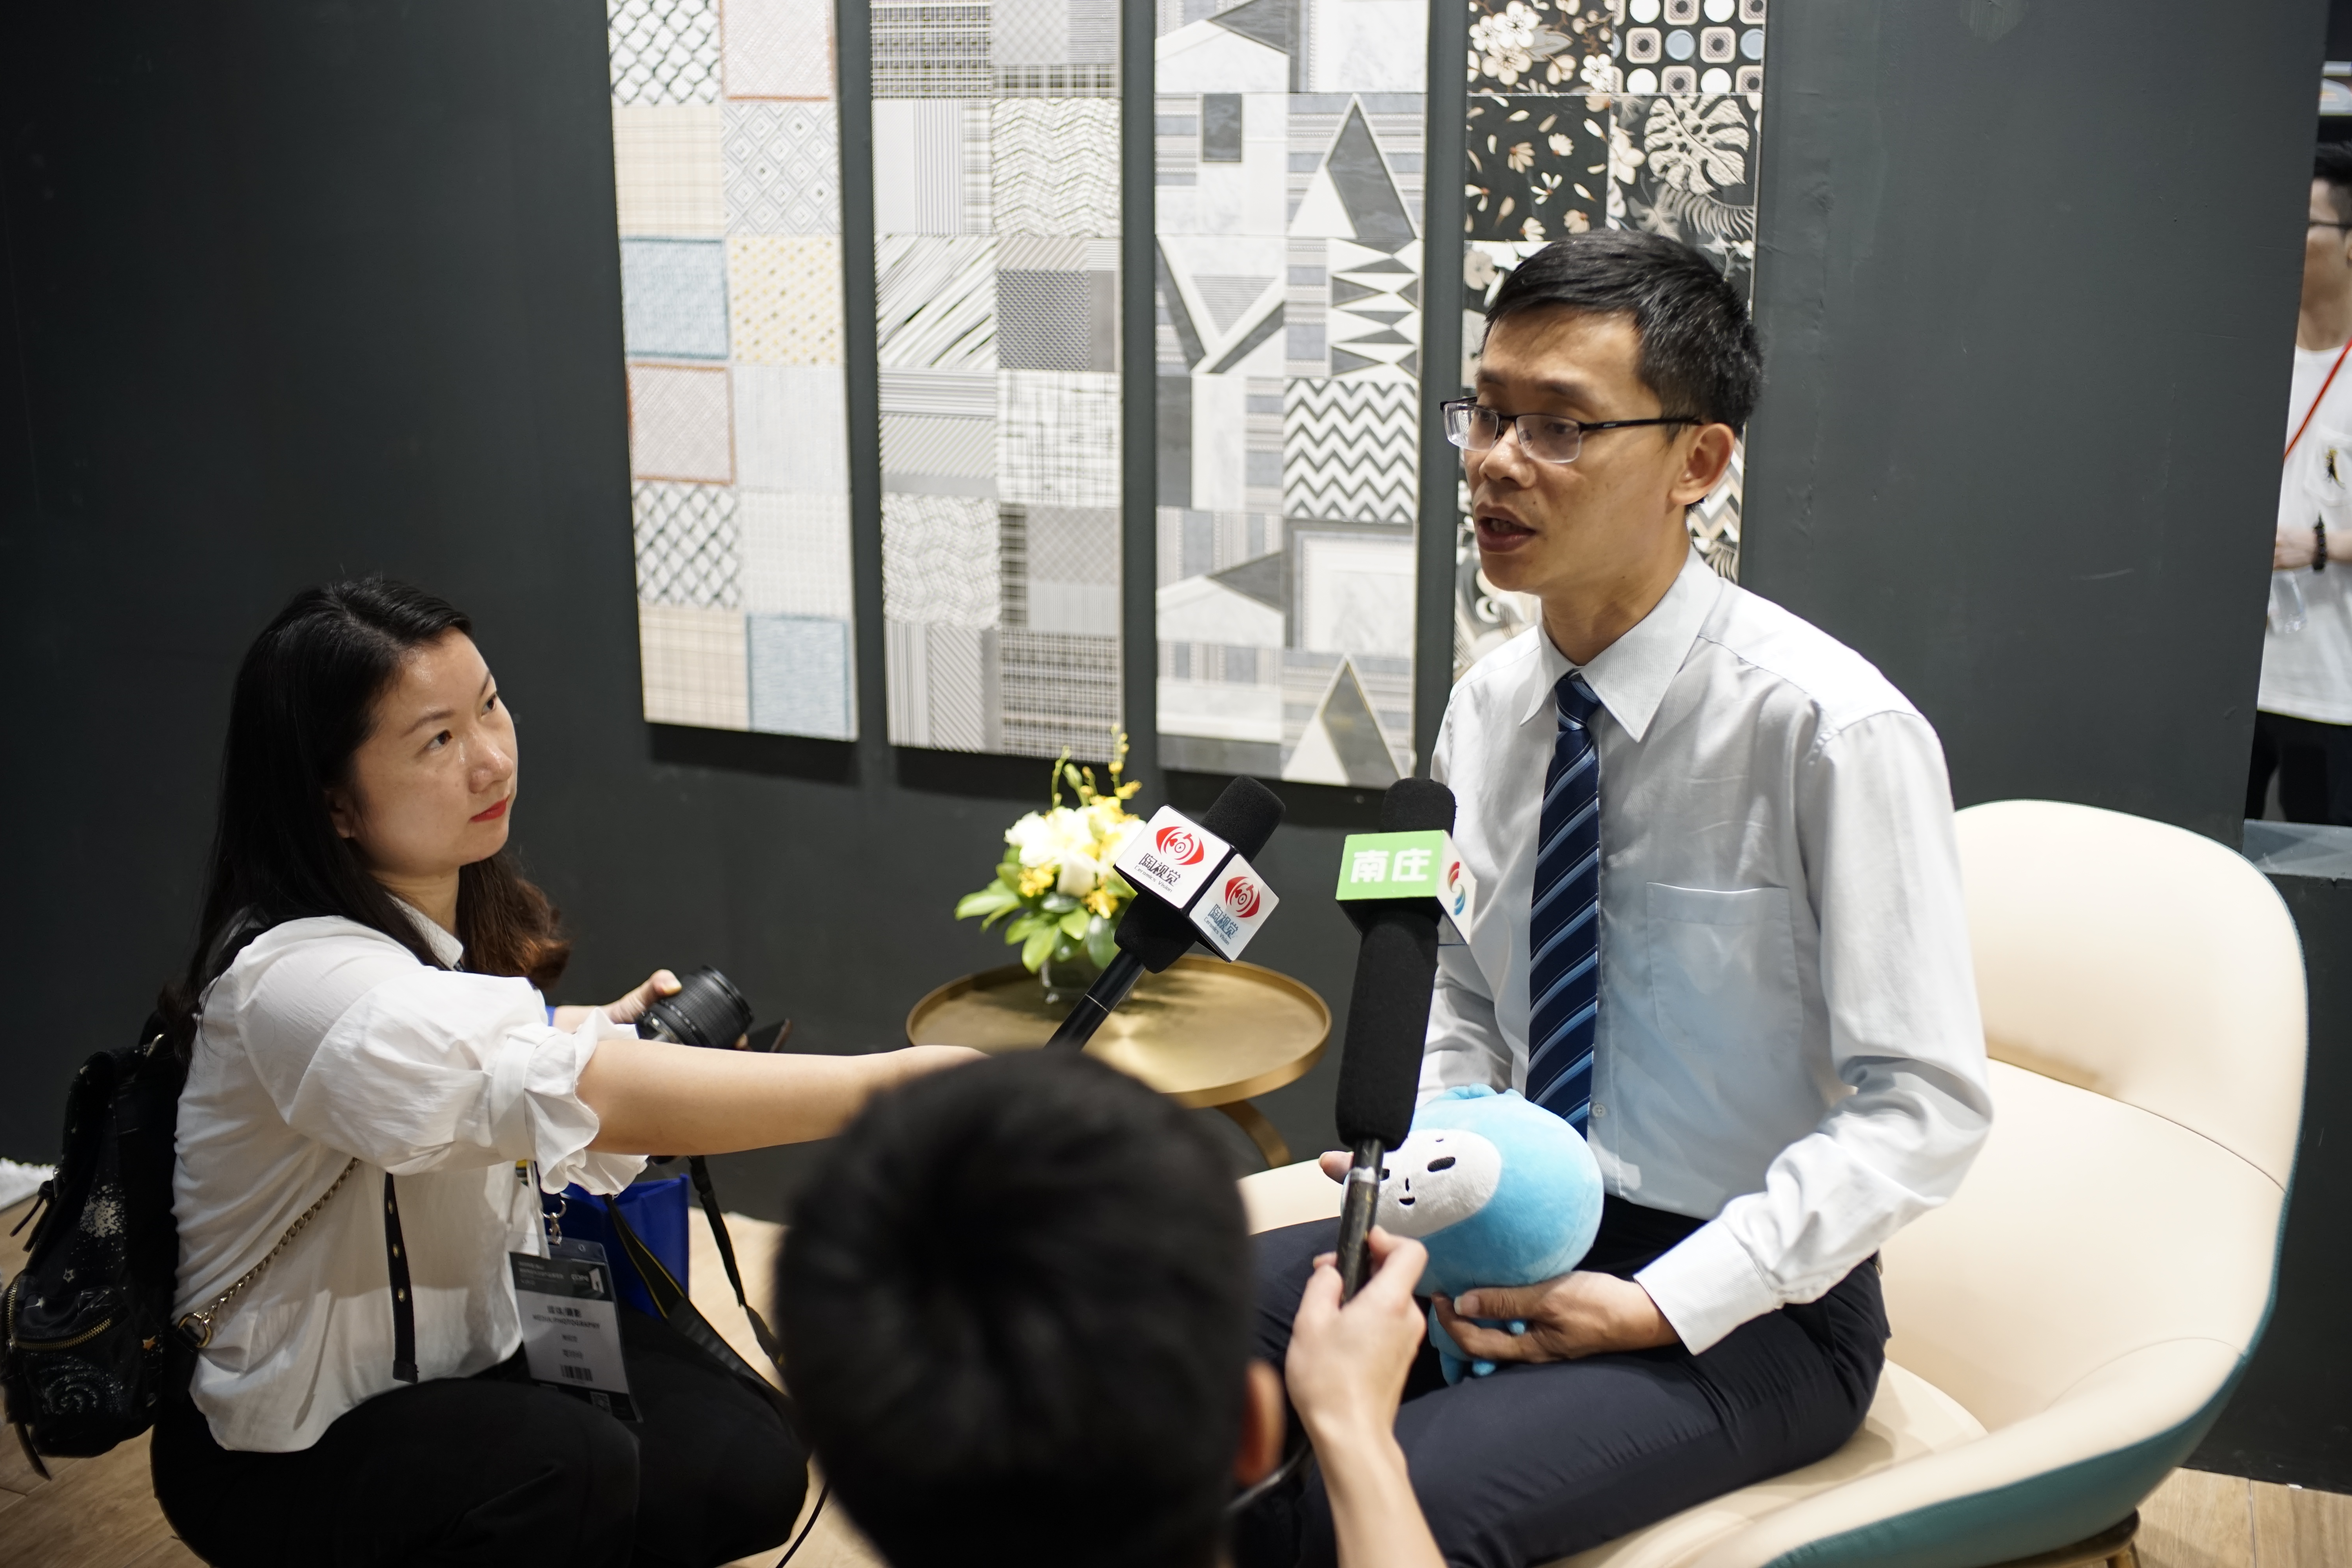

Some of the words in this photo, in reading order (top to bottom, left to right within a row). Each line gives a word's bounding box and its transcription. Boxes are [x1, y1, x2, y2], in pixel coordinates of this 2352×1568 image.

[1138, 853, 1181, 887] 陶视觉
[1350, 848, 1432, 884] 南庄
[1158, 880, 1172, 893] Vision
[1208, 903, 1238, 939] 陶视觉
[1220, 933, 1229, 946] Vision
